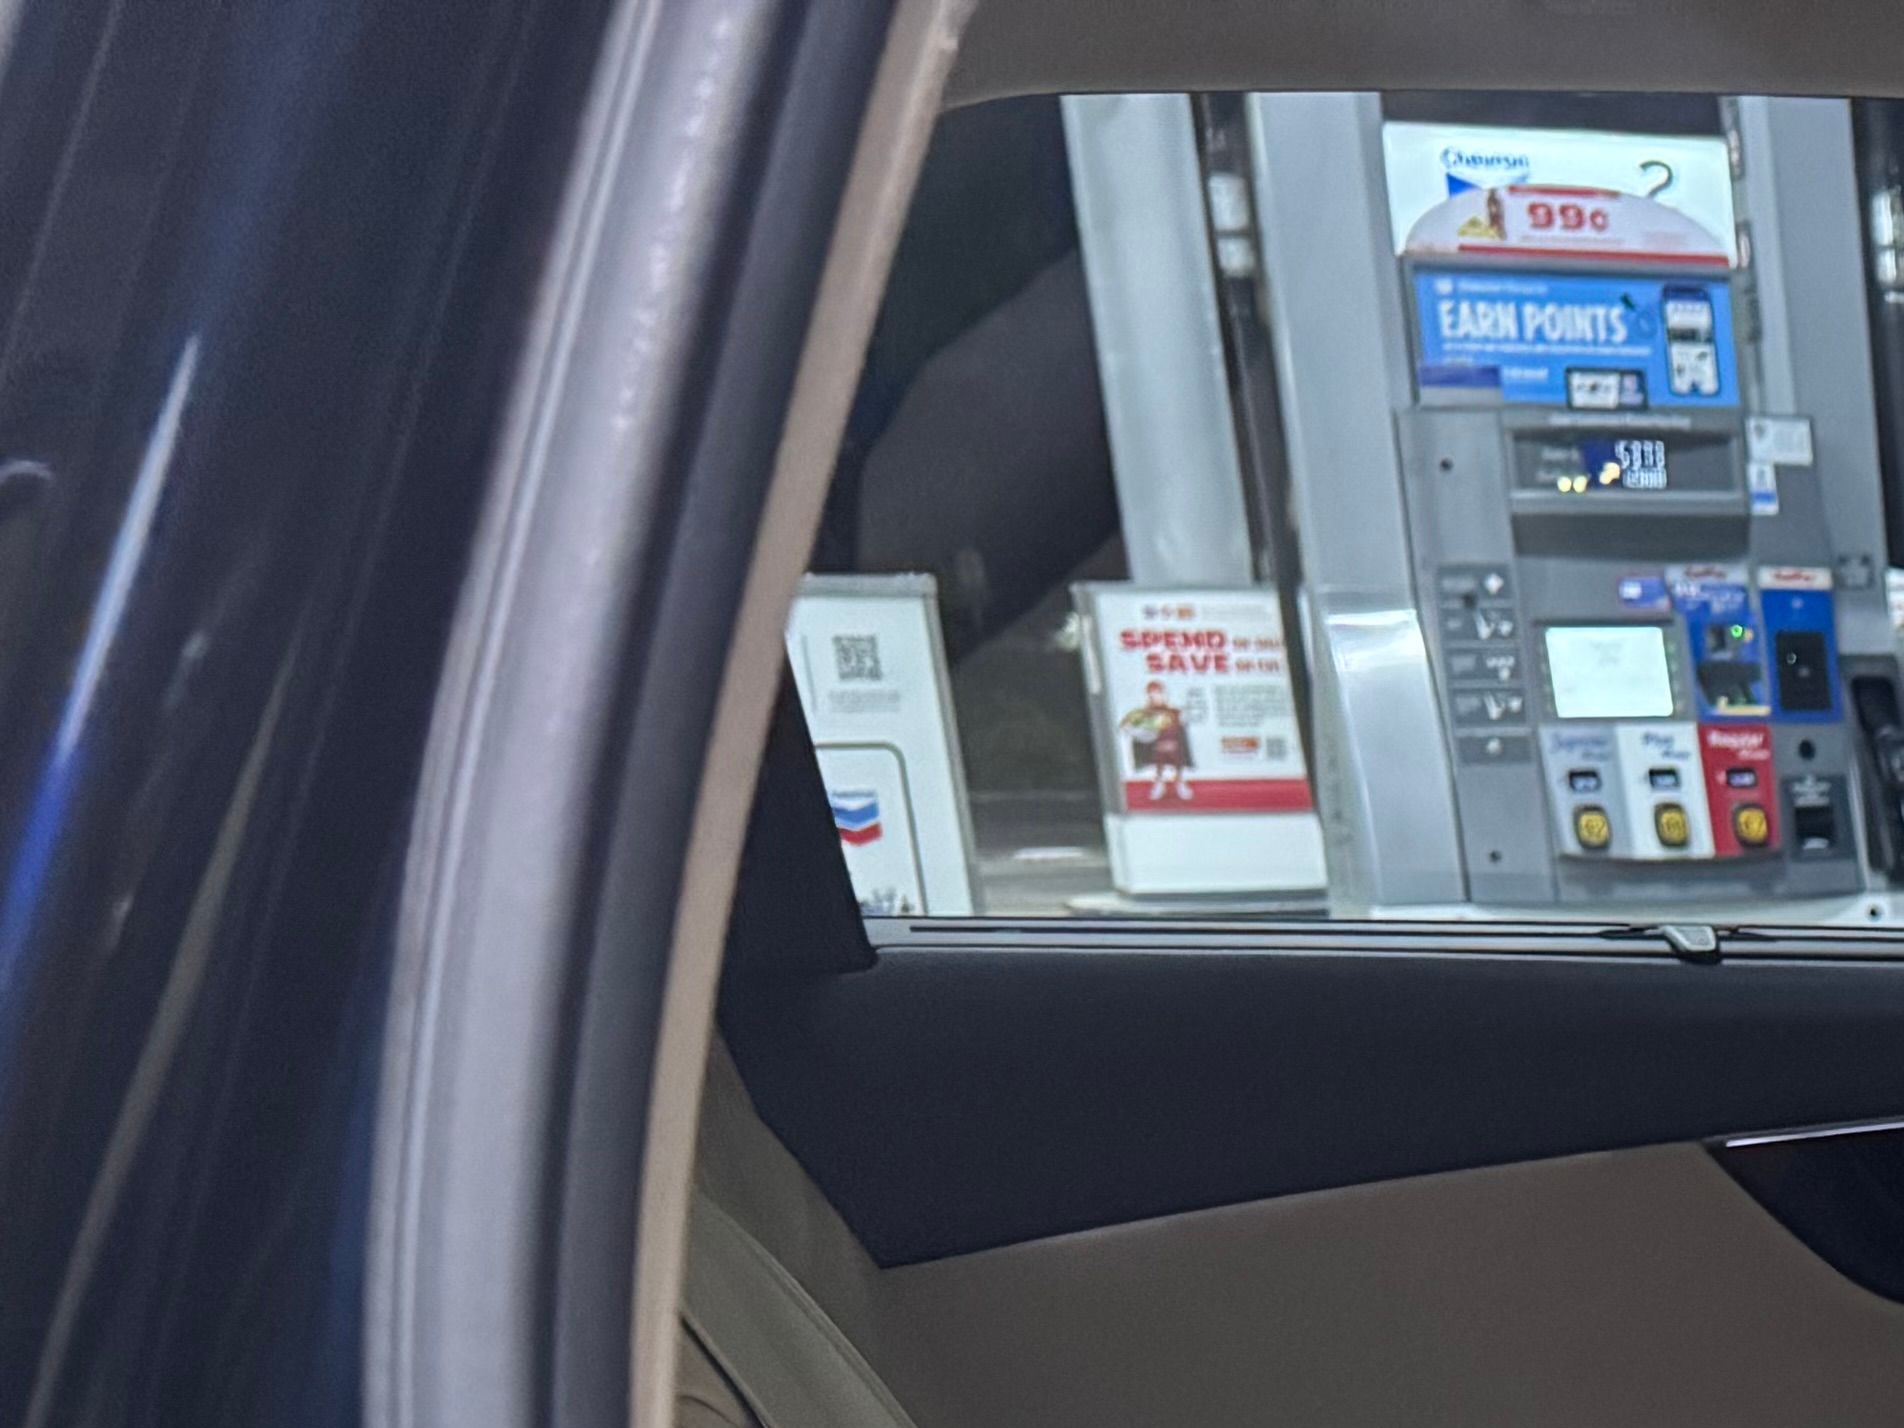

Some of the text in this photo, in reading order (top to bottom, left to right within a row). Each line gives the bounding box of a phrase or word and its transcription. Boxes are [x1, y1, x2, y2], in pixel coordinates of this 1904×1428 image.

[1438, 301, 1628, 344] EARN POINTS
[1120, 630, 1227, 650] SPEND
[1146, 653, 1228, 673] SAVE
